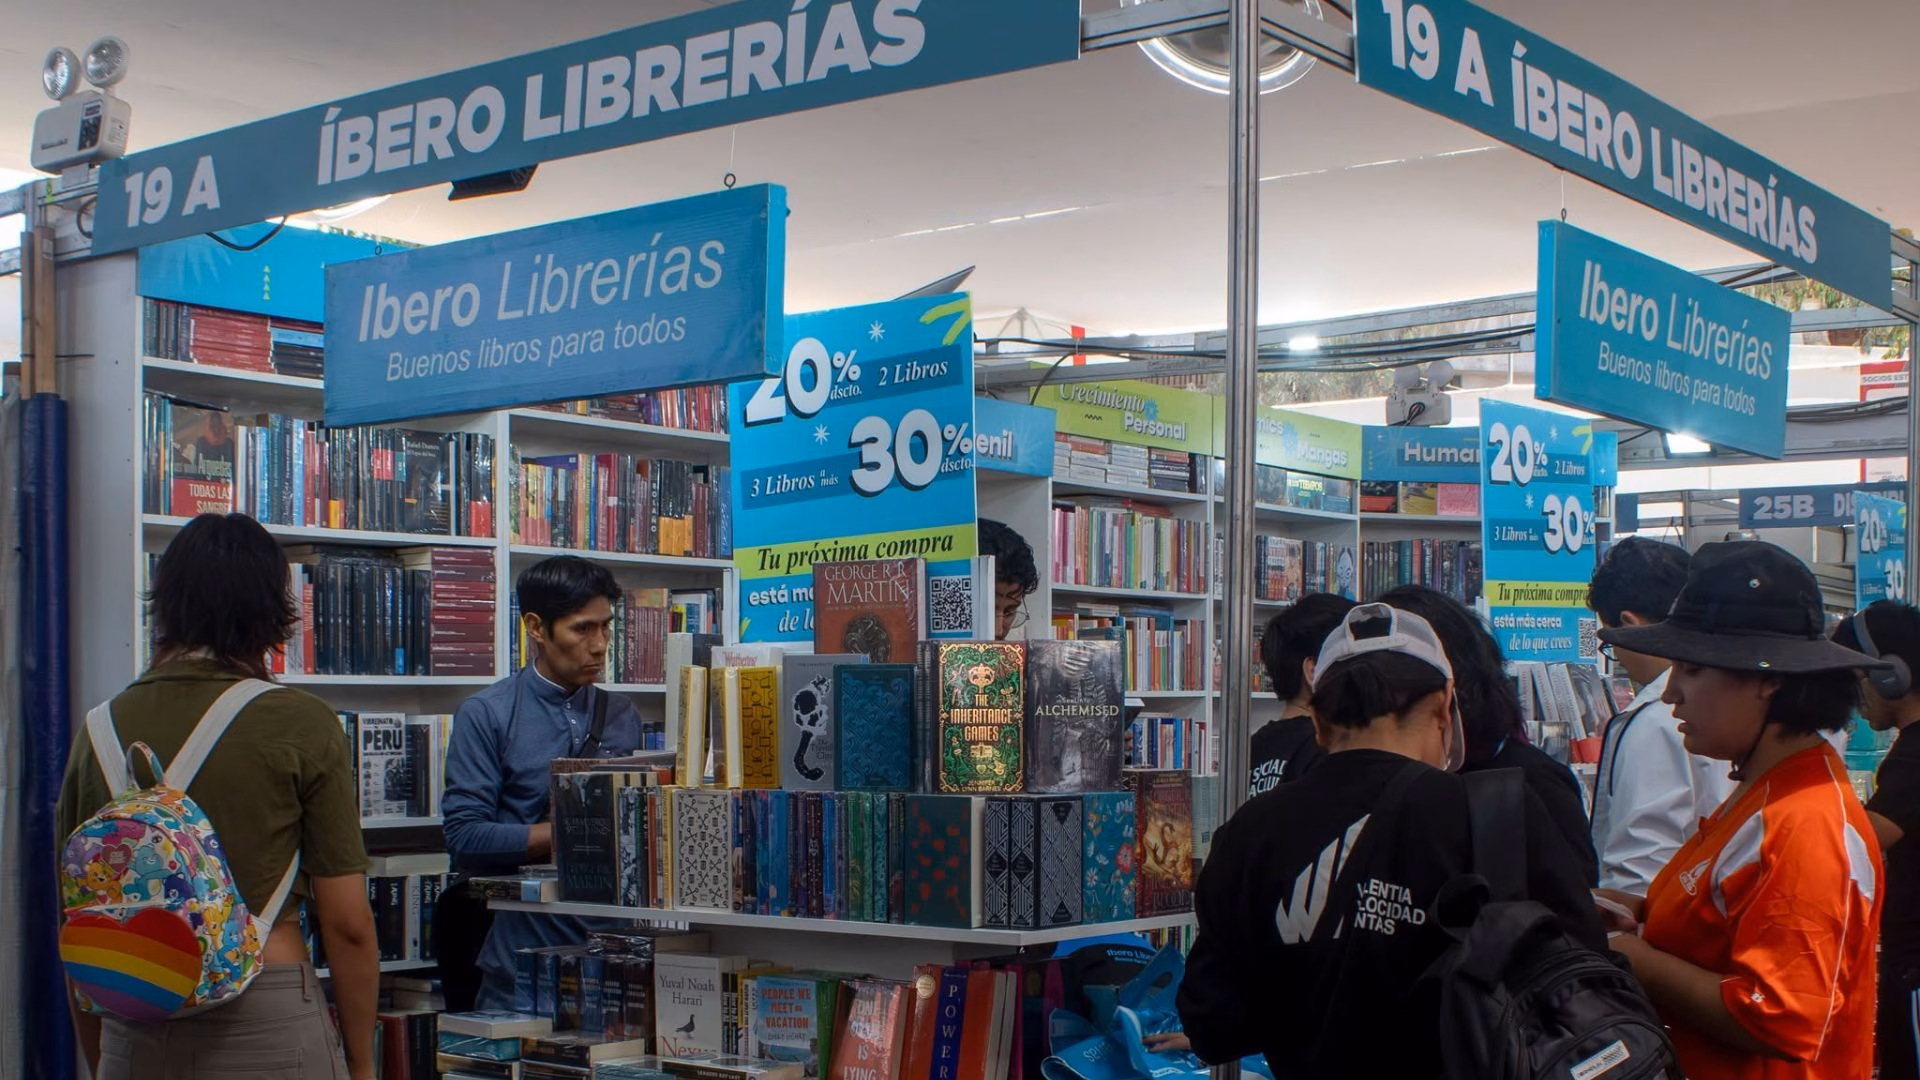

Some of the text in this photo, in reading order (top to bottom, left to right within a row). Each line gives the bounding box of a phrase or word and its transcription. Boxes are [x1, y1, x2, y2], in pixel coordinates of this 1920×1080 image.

[124, 0, 926, 228] 19 A ÍBERO LIBRERÍAS
[1382, 0, 1818, 264] 19 A ÍBERO LIBRERÍAS
[358, 231, 726, 343] Ibero Librerías
[1579, 259, 1773, 380] Ibero Librerías
[386, 312, 687, 382] Buenos libros para todos
[878, 359, 949, 387] 2 Libros
[1597, 340, 1756, 416] Buenos libros para todos
[829, 383, 863, 401] dscto.
[1059, 382, 1146, 413] Crecimiento
[1124, 411, 1187, 441] Personal
[851, 408, 973, 493] 30%
[975, 429, 1014, 460] enil
[1296, 440, 1349, 470] Mangas
[1488, 421, 1549, 485] 20%
[940, 456, 975, 473] dscto.
[1554, 460, 1561, 475] 2
[1561, 461, 1586, 476] Libros
[188, 483, 232, 500] TODAS LAS
[750, 473, 816, 498] 3 Libros
[820, 474, 839, 487] más
[1753, 494, 1816, 521] 25B
[1493, 525, 1528, 542] 3 Libros
[758, 533, 954, 575] Tu próxima compra
[824, 560, 908, 581] GEORGE R R
[749, 583, 788, 606] está
[826, 579, 910, 605] MARTIN
[1498, 582, 1511, 602] Tu
[1512, 583, 1553, 606] próxima
[778, 609, 799, 633] de
[1493, 613, 1563, 629] está más cerca
[1509, 633, 1573, 654] de lo que crees
[974, 694, 989, 708] THE
[1034, 704, 1121, 717] ALCHEMISED
[950, 708, 1013, 725] INHERITANCE
[363, 729, 403, 751] PERU
[963, 725, 1000, 742] GAMES
[1354, 911, 1396, 936] NTAS
[659, 975, 715, 992] Yuval Noah
[761, 987, 811, 1001] PEOPLE WE
[672, 991, 703, 1007] Harari
[770, 1002, 793, 1014] MEET
[765, 1017, 809, 1030] VACATION
[939, 983, 959, 1080] POWER
[857, 1044, 870, 1061] IS
[843, 1065, 877, 1080] LYING
